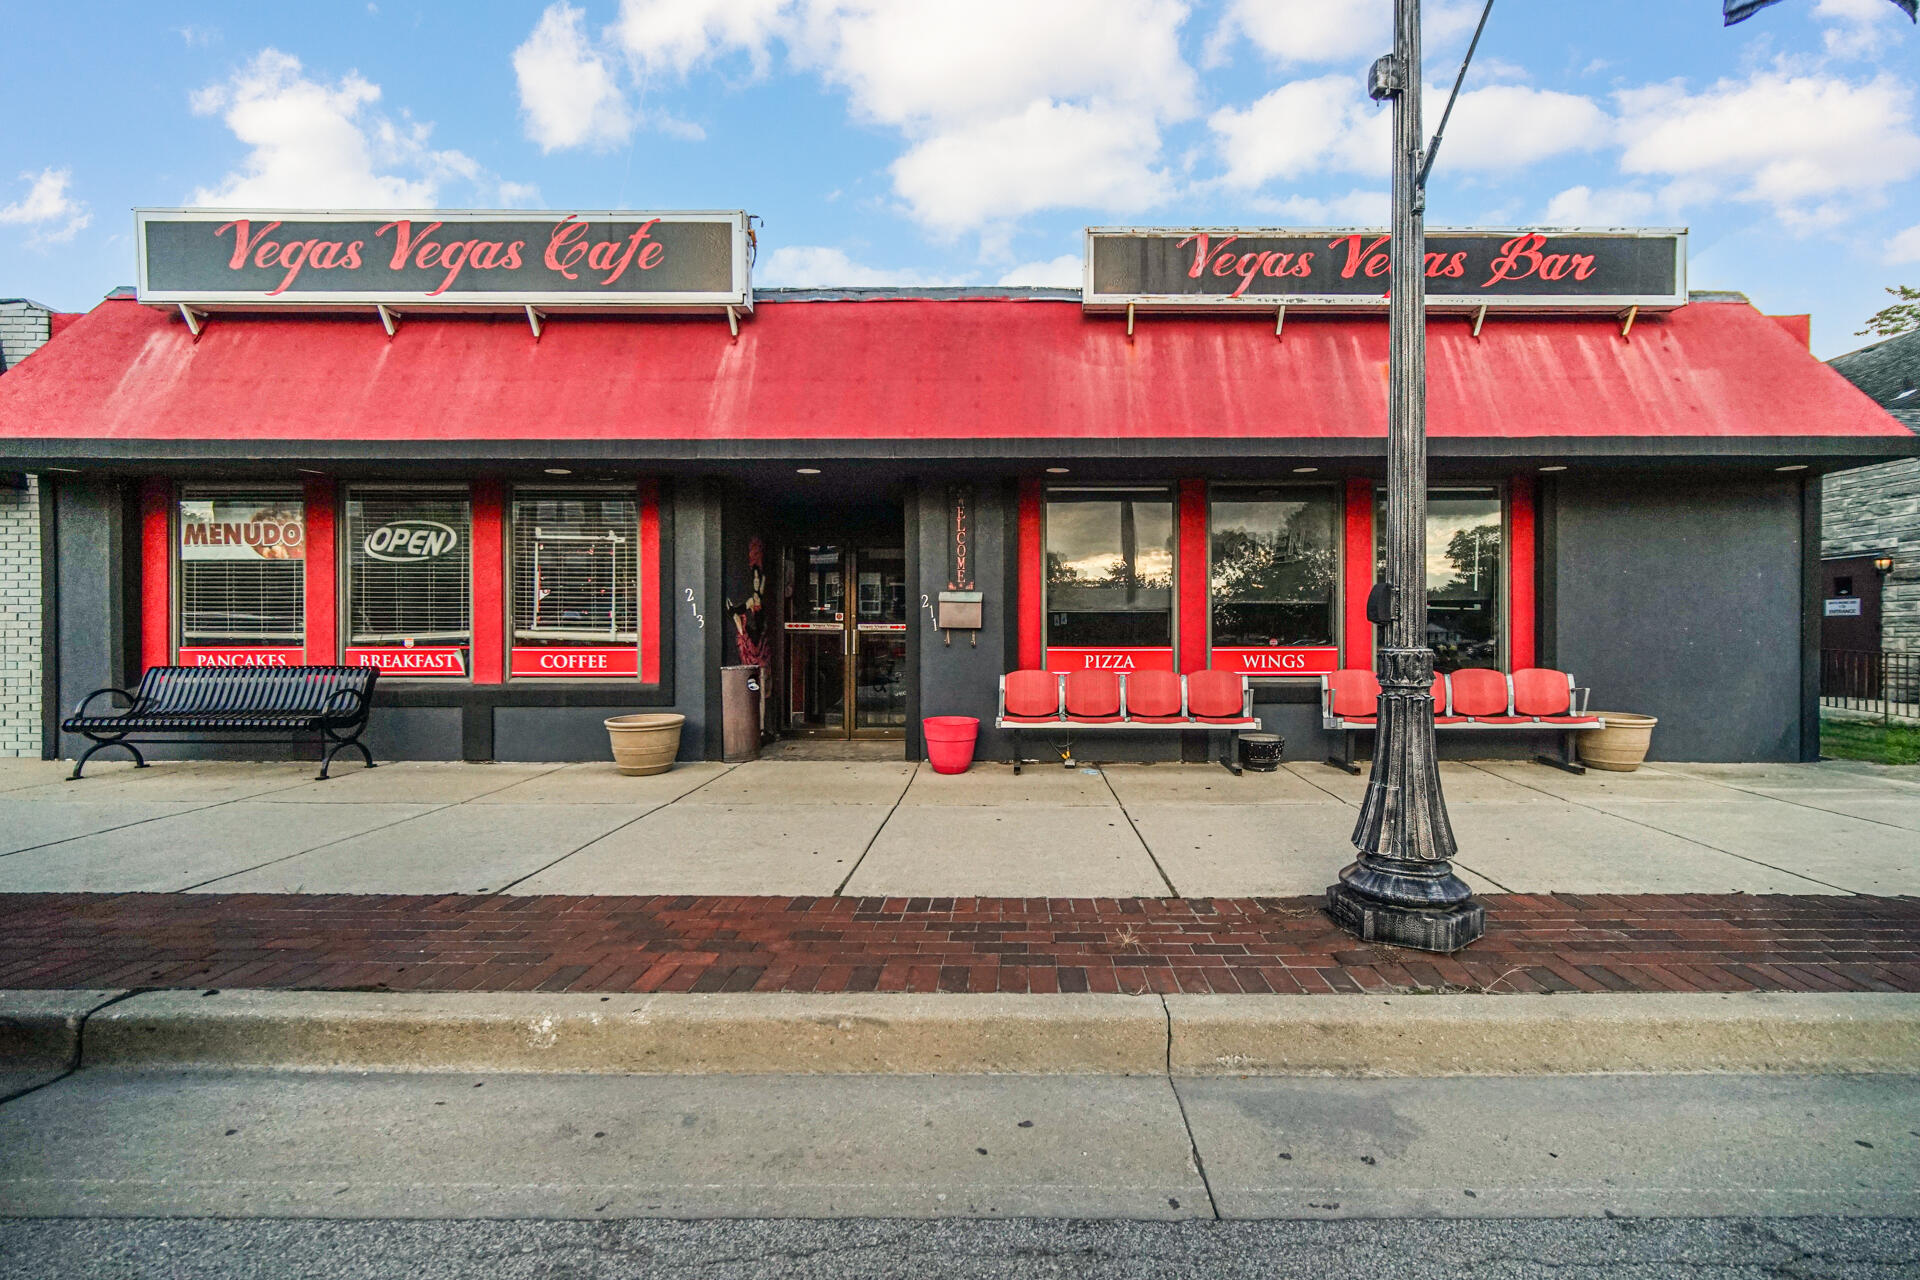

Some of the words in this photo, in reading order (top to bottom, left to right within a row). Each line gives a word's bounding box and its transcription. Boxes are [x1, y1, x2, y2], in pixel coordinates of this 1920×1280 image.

[214, 219, 364, 296] Vegas
[375, 219, 525, 296] Vegas
[544, 214, 665, 286] Cafe
[1176, 232, 1313, 298] Vegas
[1328, 233, 1466, 299] Veas
[1482, 231, 1597, 288] Bar
[183, 522, 303, 546] MENUDO
[370, 527, 447, 556] OPEN
[684, 587, 705, 629] 213
[921, 594, 937, 631] 211
[197, 654, 287, 666] PANCAKES
[359, 654, 455, 668] BREAKFAST
[540, 654, 608, 669] COFFEE
[1084, 654, 1136, 669] PIZZA
[1242, 654, 1305, 669] WINGS
